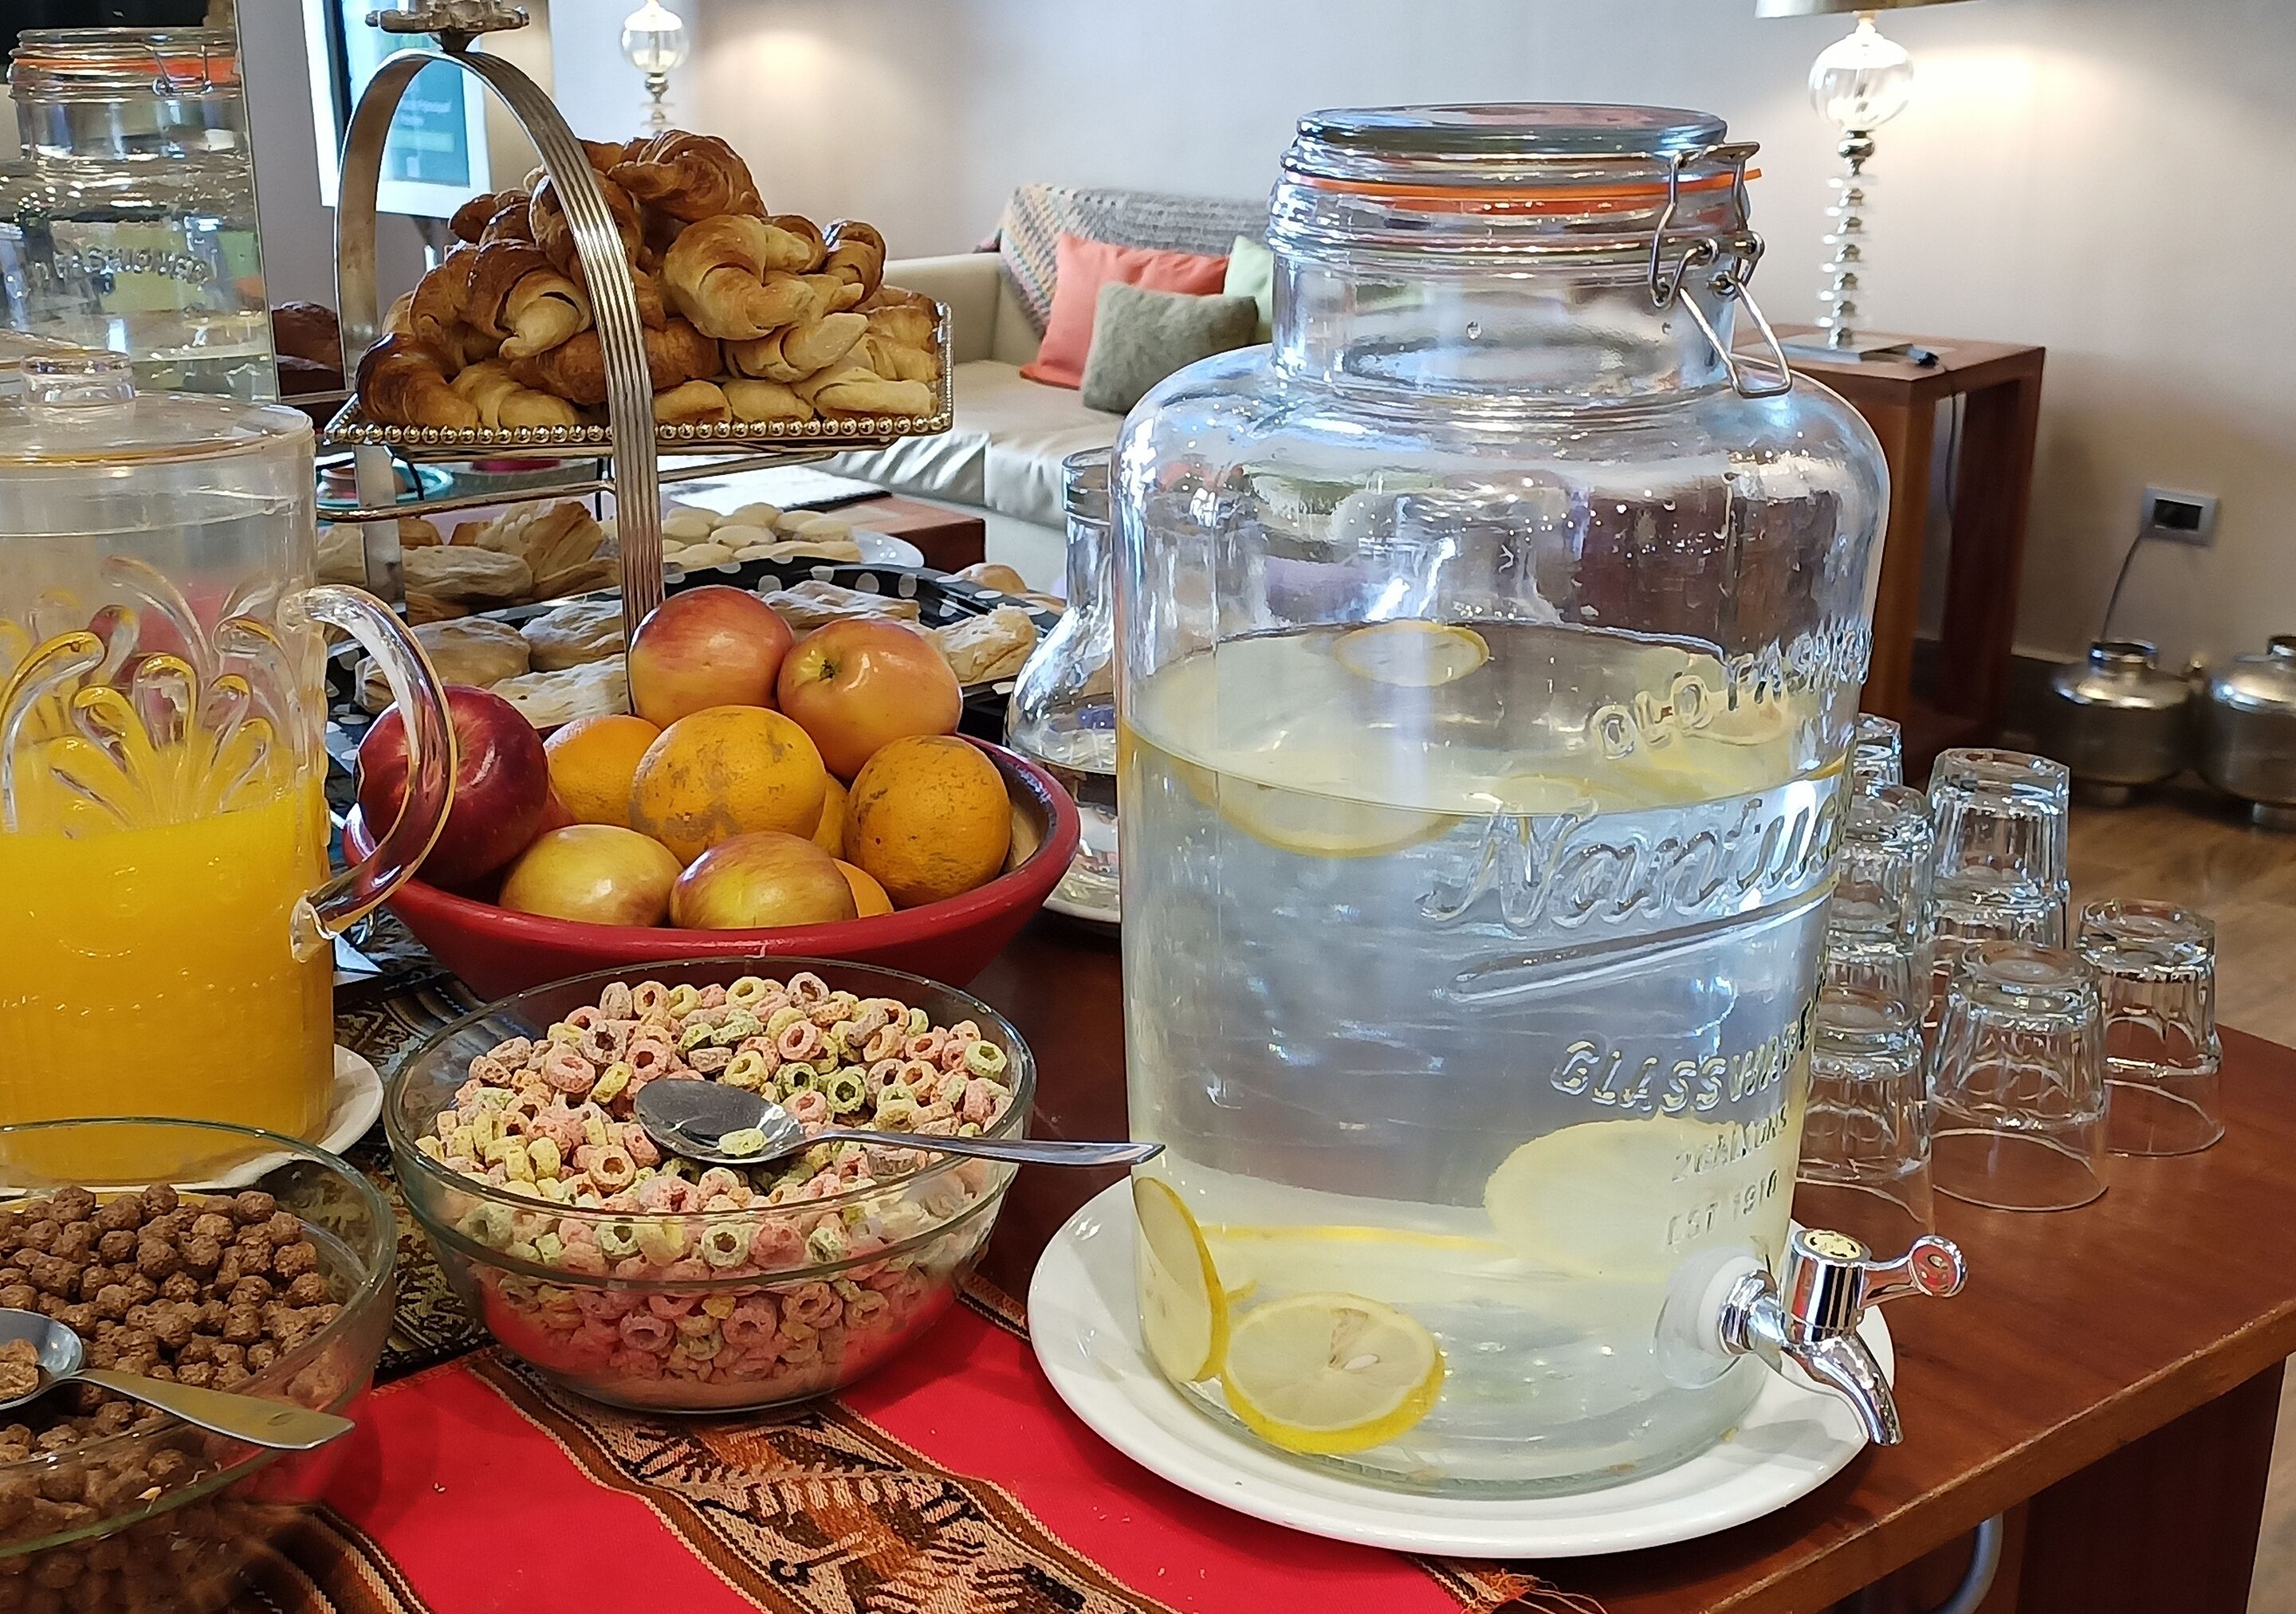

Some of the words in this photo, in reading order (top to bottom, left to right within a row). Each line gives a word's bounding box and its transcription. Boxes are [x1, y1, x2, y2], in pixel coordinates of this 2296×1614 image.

[1590, 674, 1713, 760] OLD
[1667, 1202, 1719, 1248] EST
[1733, 1168, 1778, 1222] 1910
